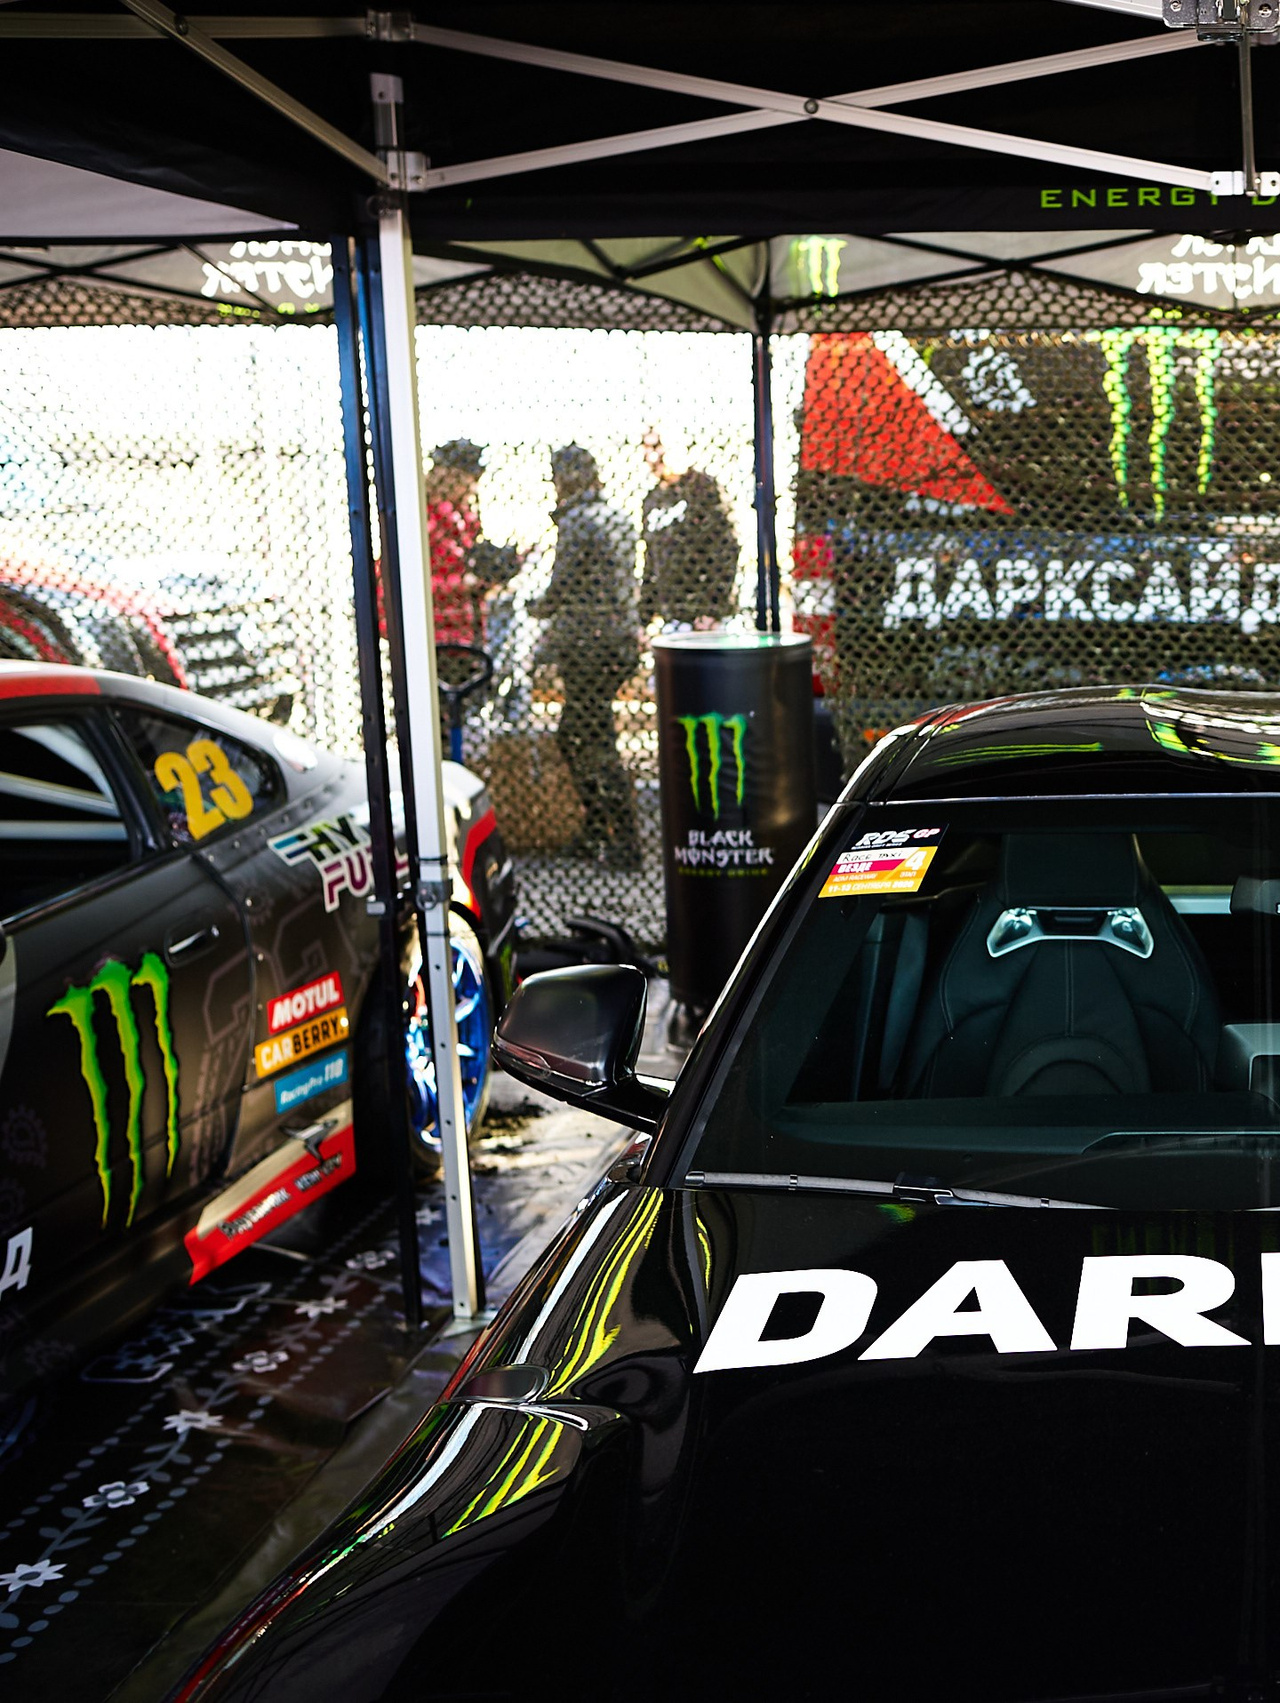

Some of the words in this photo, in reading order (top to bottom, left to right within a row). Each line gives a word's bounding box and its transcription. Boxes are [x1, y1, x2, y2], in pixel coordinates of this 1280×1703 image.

[154, 738, 254, 840] 23
[688, 829, 754, 847] BLACK
[855, 829, 917, 846] RDS
[675, 846, 774, 868] MONSTER
[904, 851, 927, 870] 4
[271, 977, 340, 1030] MOTUL
